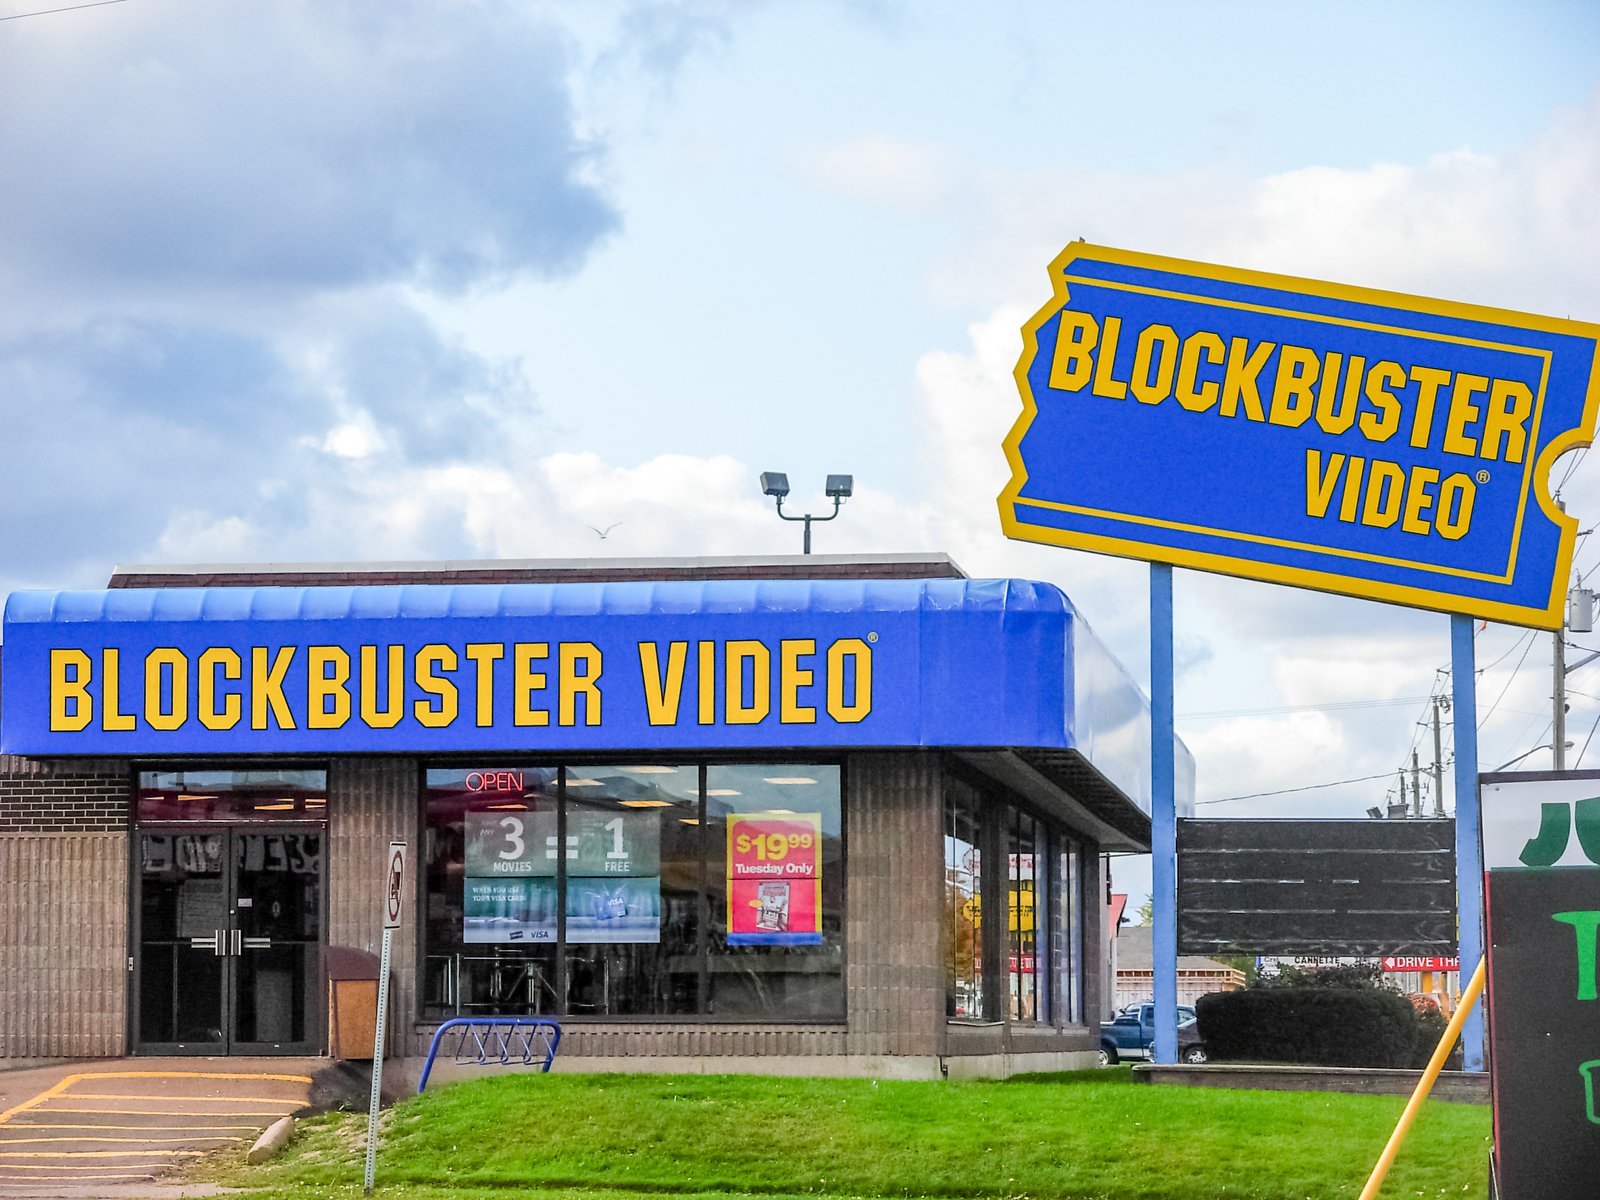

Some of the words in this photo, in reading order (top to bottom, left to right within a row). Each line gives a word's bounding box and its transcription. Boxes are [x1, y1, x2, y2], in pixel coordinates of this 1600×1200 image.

[1048, 309, 1533, 463] BLOCKBUSTER
[1306, 448, 1477, 540] VIDEO
[49, 642, 603, 733] BLOCKBUSTER
[638, 638, 872, 726] VIDEO
[465, 771, 523, 791] OPEN
[499, 816, 525, 860] 3
[605, 817, 628, 859] 1
[493, 862, 532, 873] MOVIES
[604, 861, 630, 872] FREE
[735, 863, 784, 875] Tuesday
[785, 863, 813, 875] Only
[608, 898, 624, 906] VISA
[1396, 956, 1434, 968] DRIVE
